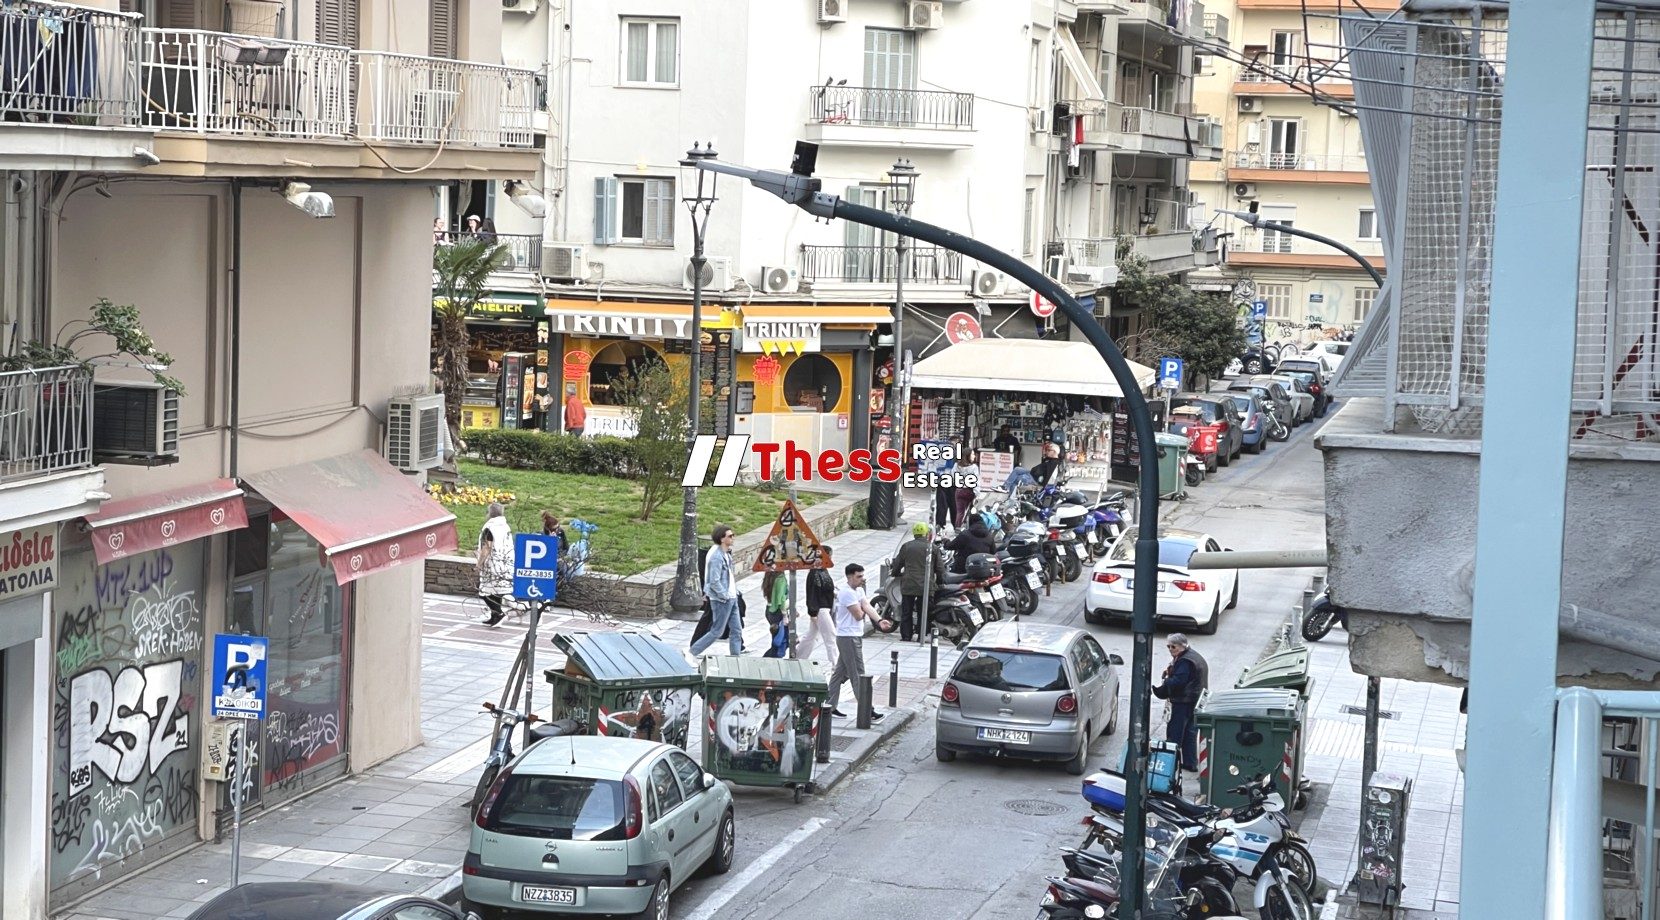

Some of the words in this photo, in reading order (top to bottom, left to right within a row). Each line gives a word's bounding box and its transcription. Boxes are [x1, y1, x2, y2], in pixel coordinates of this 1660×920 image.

[746, 323, 821, 338] TRINITY
[1166, 361, 1179, 376] P
[0, 531, 54, 572] ιδεία
[524, 540, 548, 568] P
[517, 570, 552, 578] NZZ-3835
[218, 698, 259, 709] ΚΟΙΚΟΙ
[1148, 759, 1165, 771] olt
[1244, 832, 1269, 844] RS
[524, 888, 544, 900] NZZ
[548, 889, 573, 902] 3835
